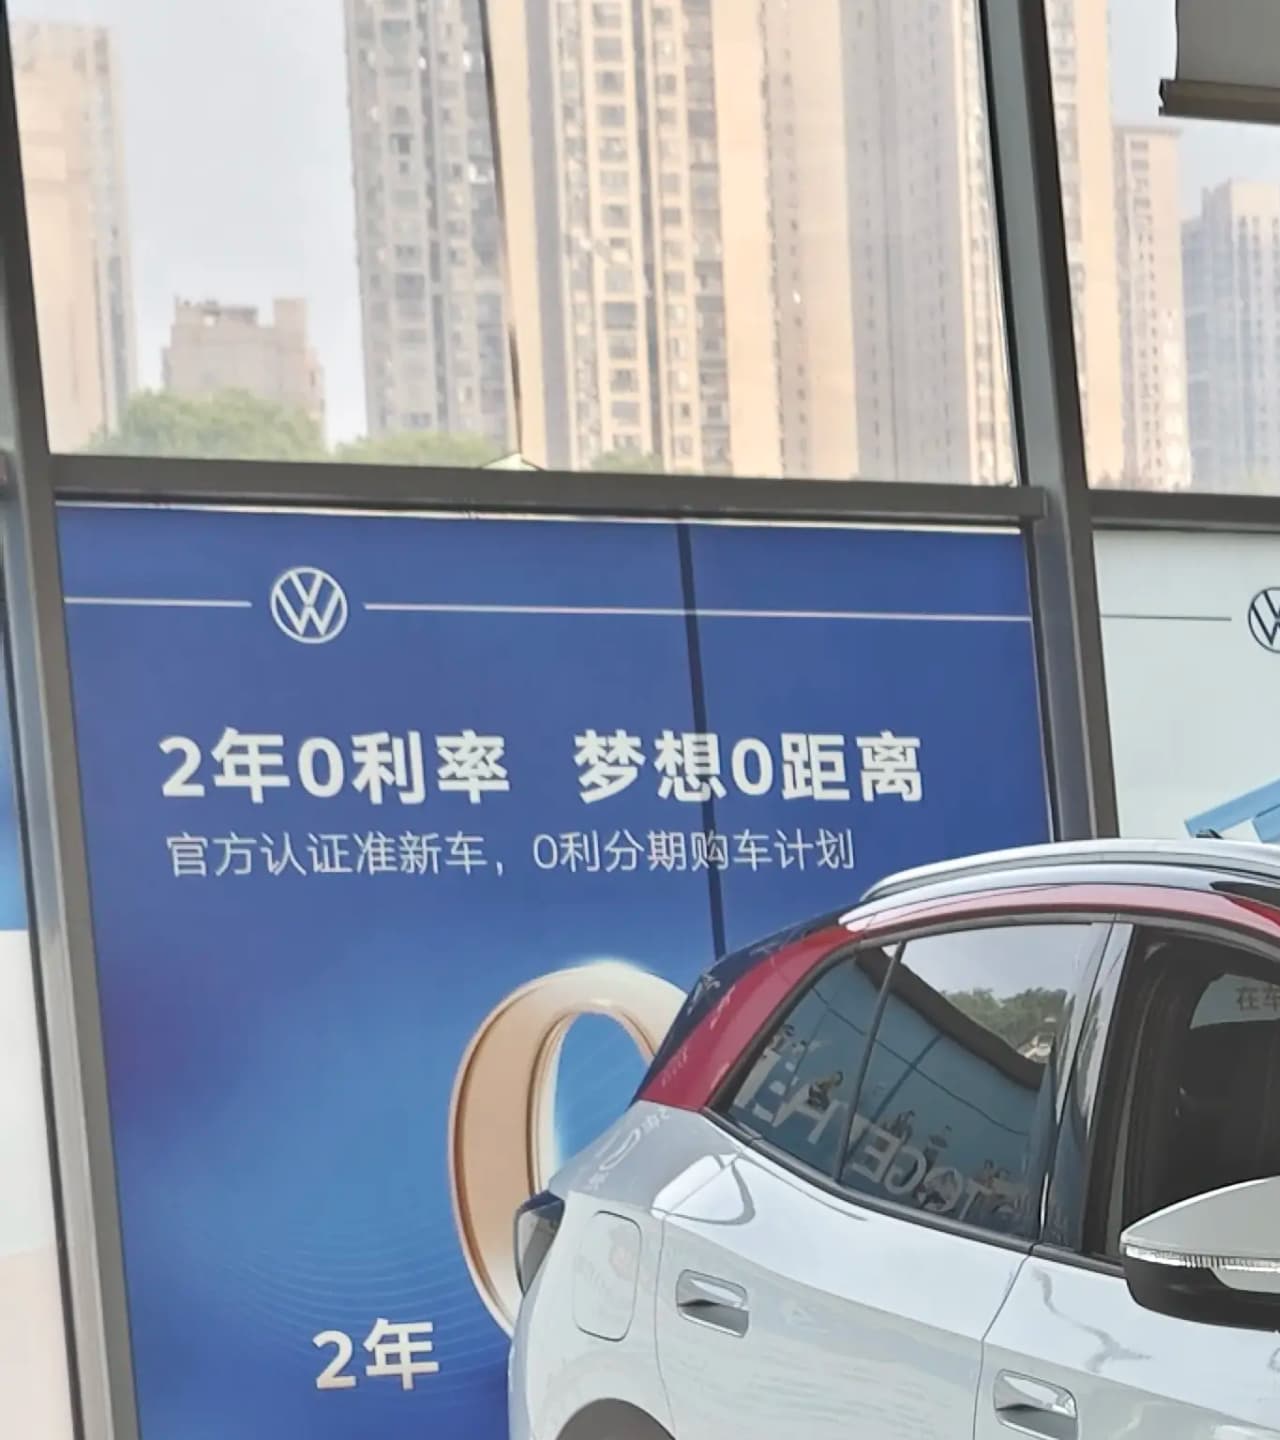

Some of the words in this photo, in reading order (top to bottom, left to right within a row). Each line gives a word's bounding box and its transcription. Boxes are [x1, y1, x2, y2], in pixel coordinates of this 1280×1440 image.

[159, 727, 510, 804] 2年0利率
[574, 728, 925, 804] 梦想0距离
[312, 1318, 440, 1390] 2年
